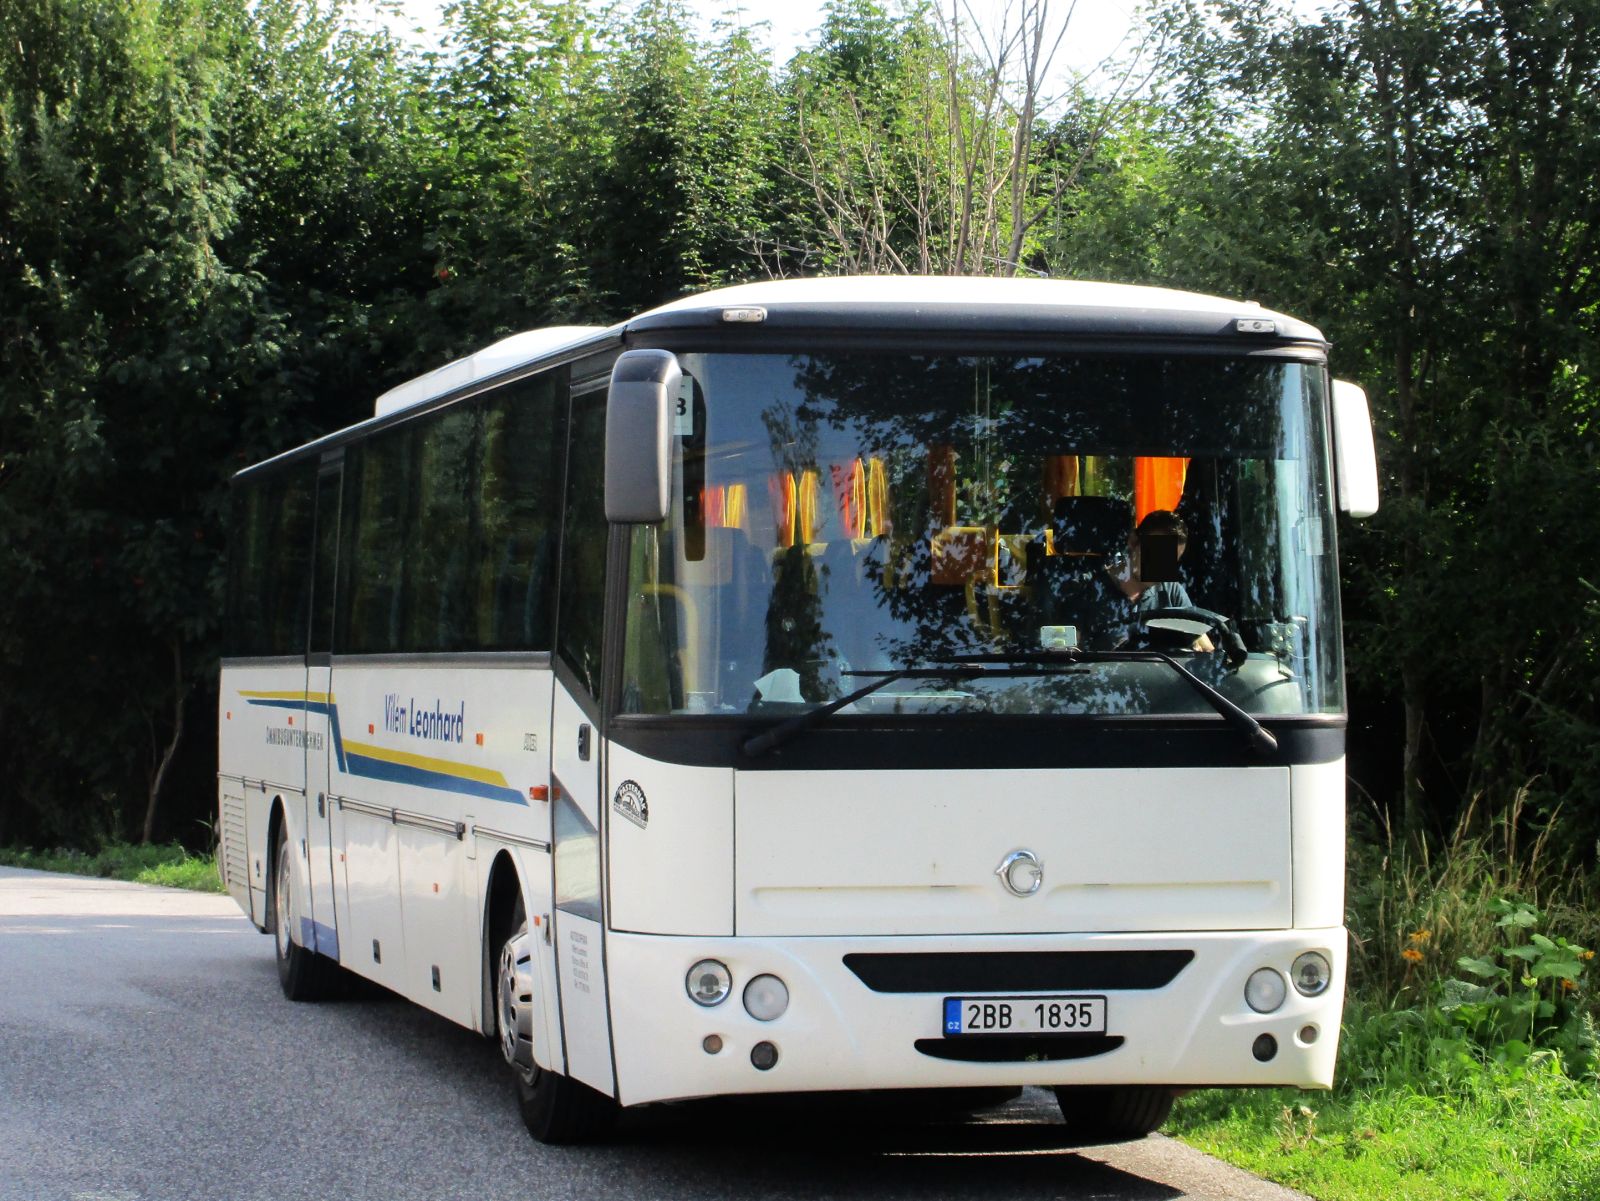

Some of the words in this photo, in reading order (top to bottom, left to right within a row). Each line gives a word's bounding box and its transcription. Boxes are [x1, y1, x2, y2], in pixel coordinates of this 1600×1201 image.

[385, 692, 407, 734] Vilém
[410, 697, 465, 744] Leonhard
[947, 1021, 961, 1030] CZ
[967, 1003, 1013, 1029] 2BB
[1034, 1003, 1092, 1029] 1835
